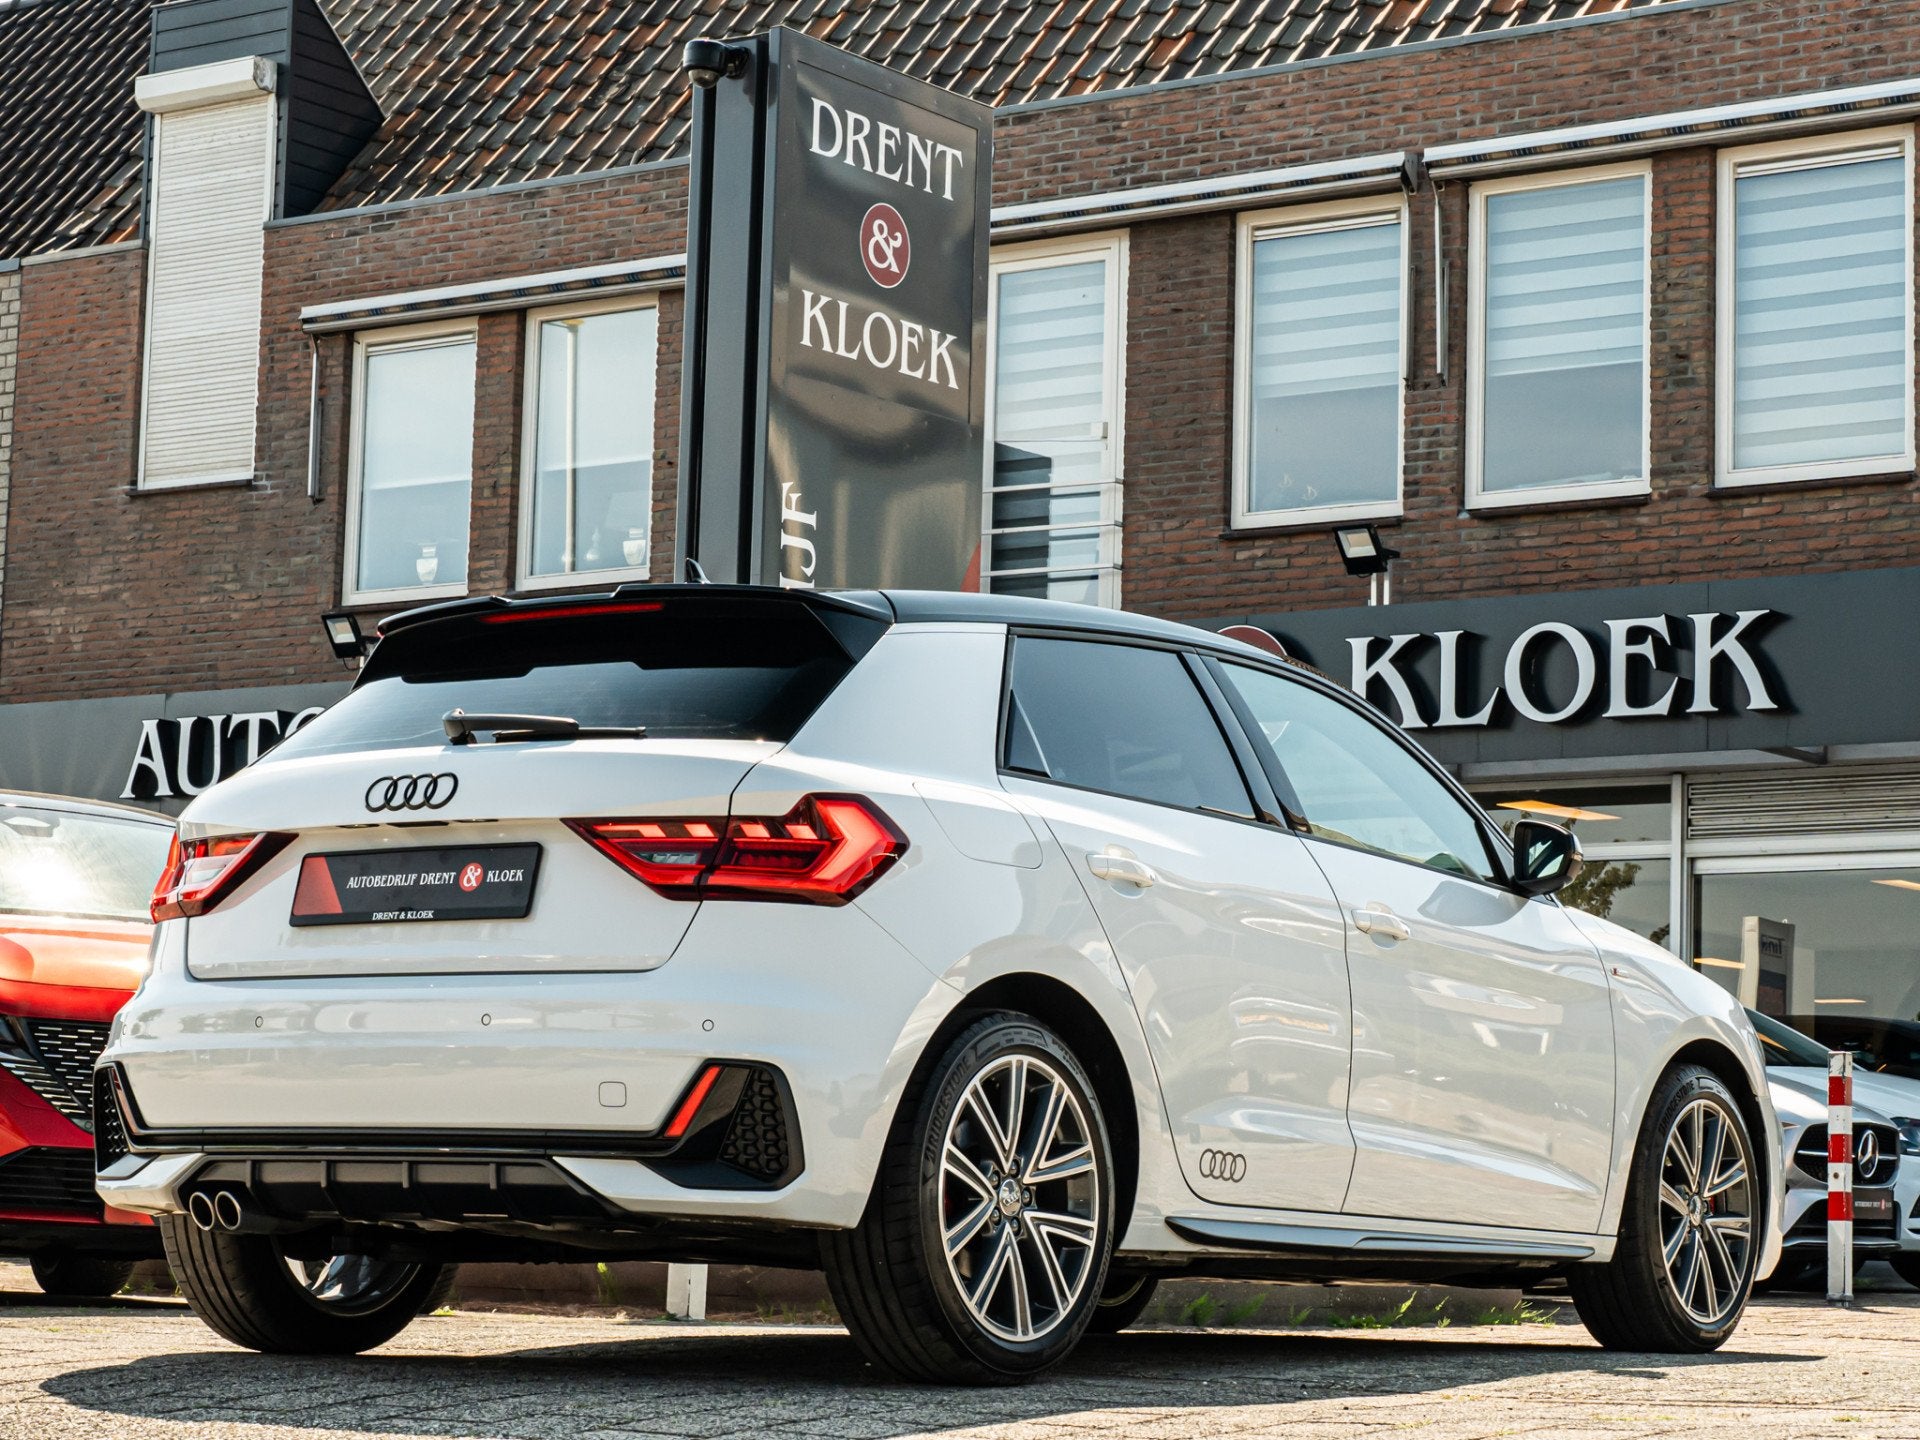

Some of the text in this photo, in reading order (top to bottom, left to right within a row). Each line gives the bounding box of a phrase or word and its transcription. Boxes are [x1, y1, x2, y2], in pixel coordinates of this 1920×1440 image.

[808, 96, 964, 201] DRENT
[867, 218, 903, 274] &
[799, 289, 960, 390] KLOEK
[1344, 608, 1779, 730] KLOEK
[346, 865, 525, 889] AUTOBEDRIJF DRENT & KLOEK
[372, 910, 435, 921] DRENT & KLOEK
[924, 1055, 972, 1165] BRIDGESTONE
